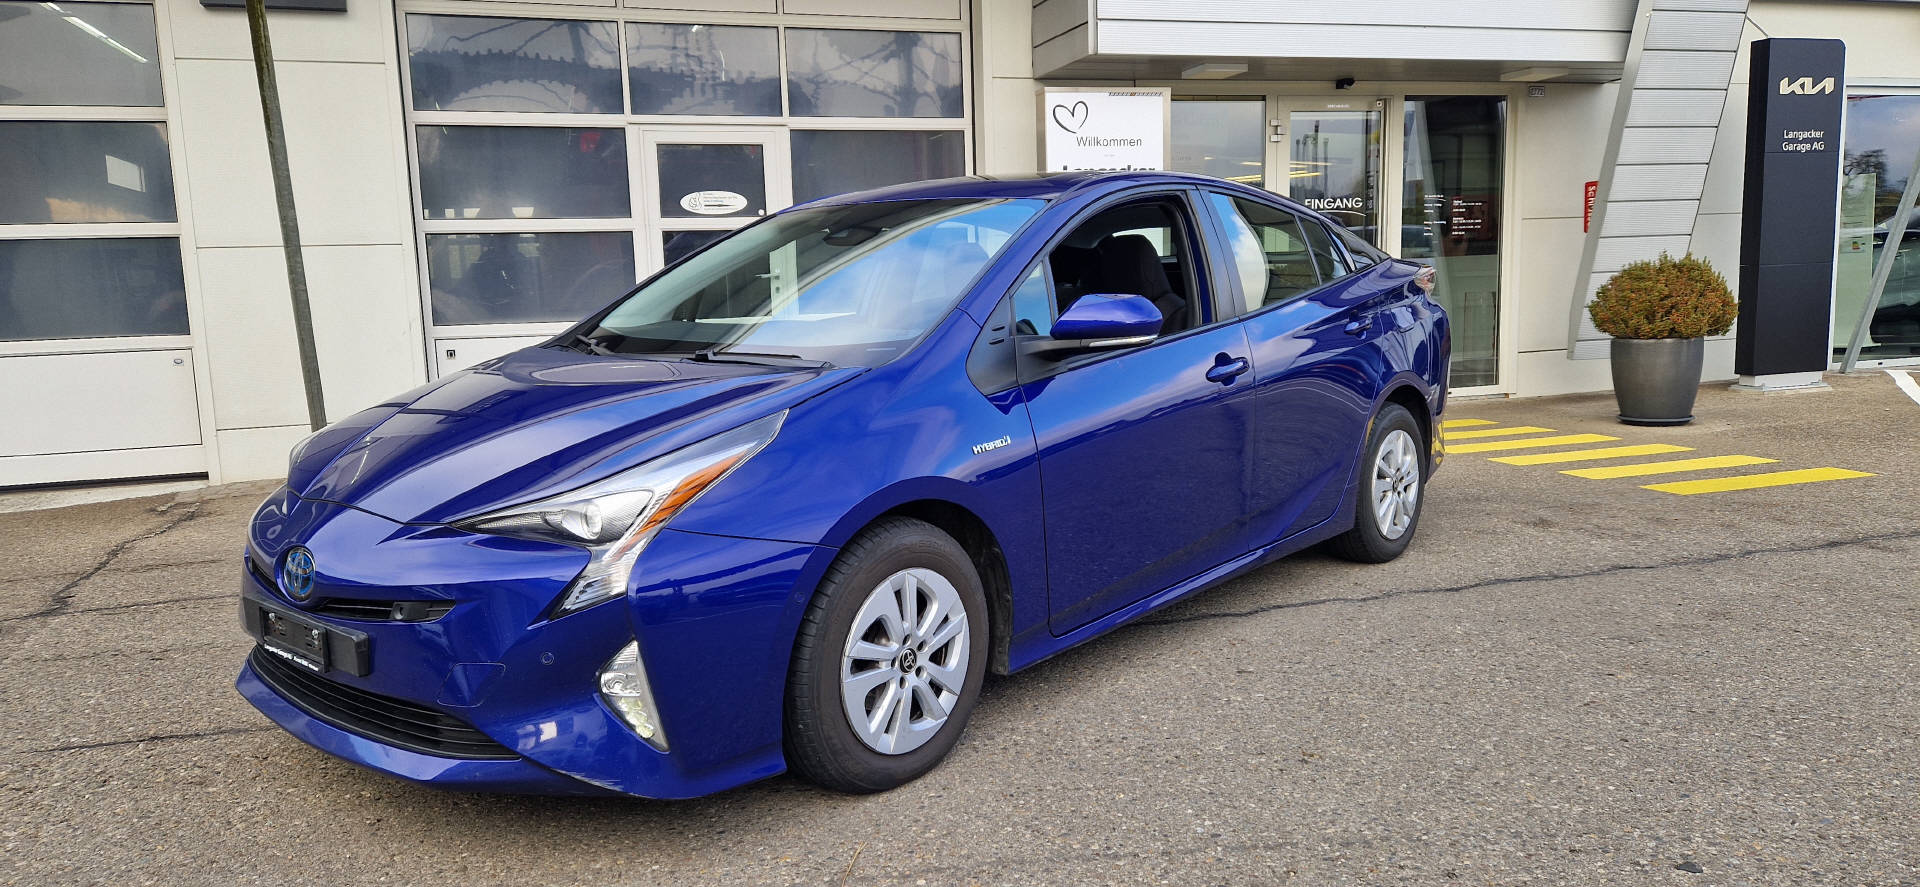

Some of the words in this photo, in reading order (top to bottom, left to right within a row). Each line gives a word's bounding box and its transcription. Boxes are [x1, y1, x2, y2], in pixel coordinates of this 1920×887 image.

[1779, 77, 1835, 95] KIA
[1783, 129, 1825, 140] Langacker
[1076, 136, 1142, 147] Willkommen
[1782, 141, 1812, 153] Garage
[1812, 141, 1825, 151] AG
[1304, 197, 1363, 209] EINGANG
[972, 437, 1006, 455] HYBRID
